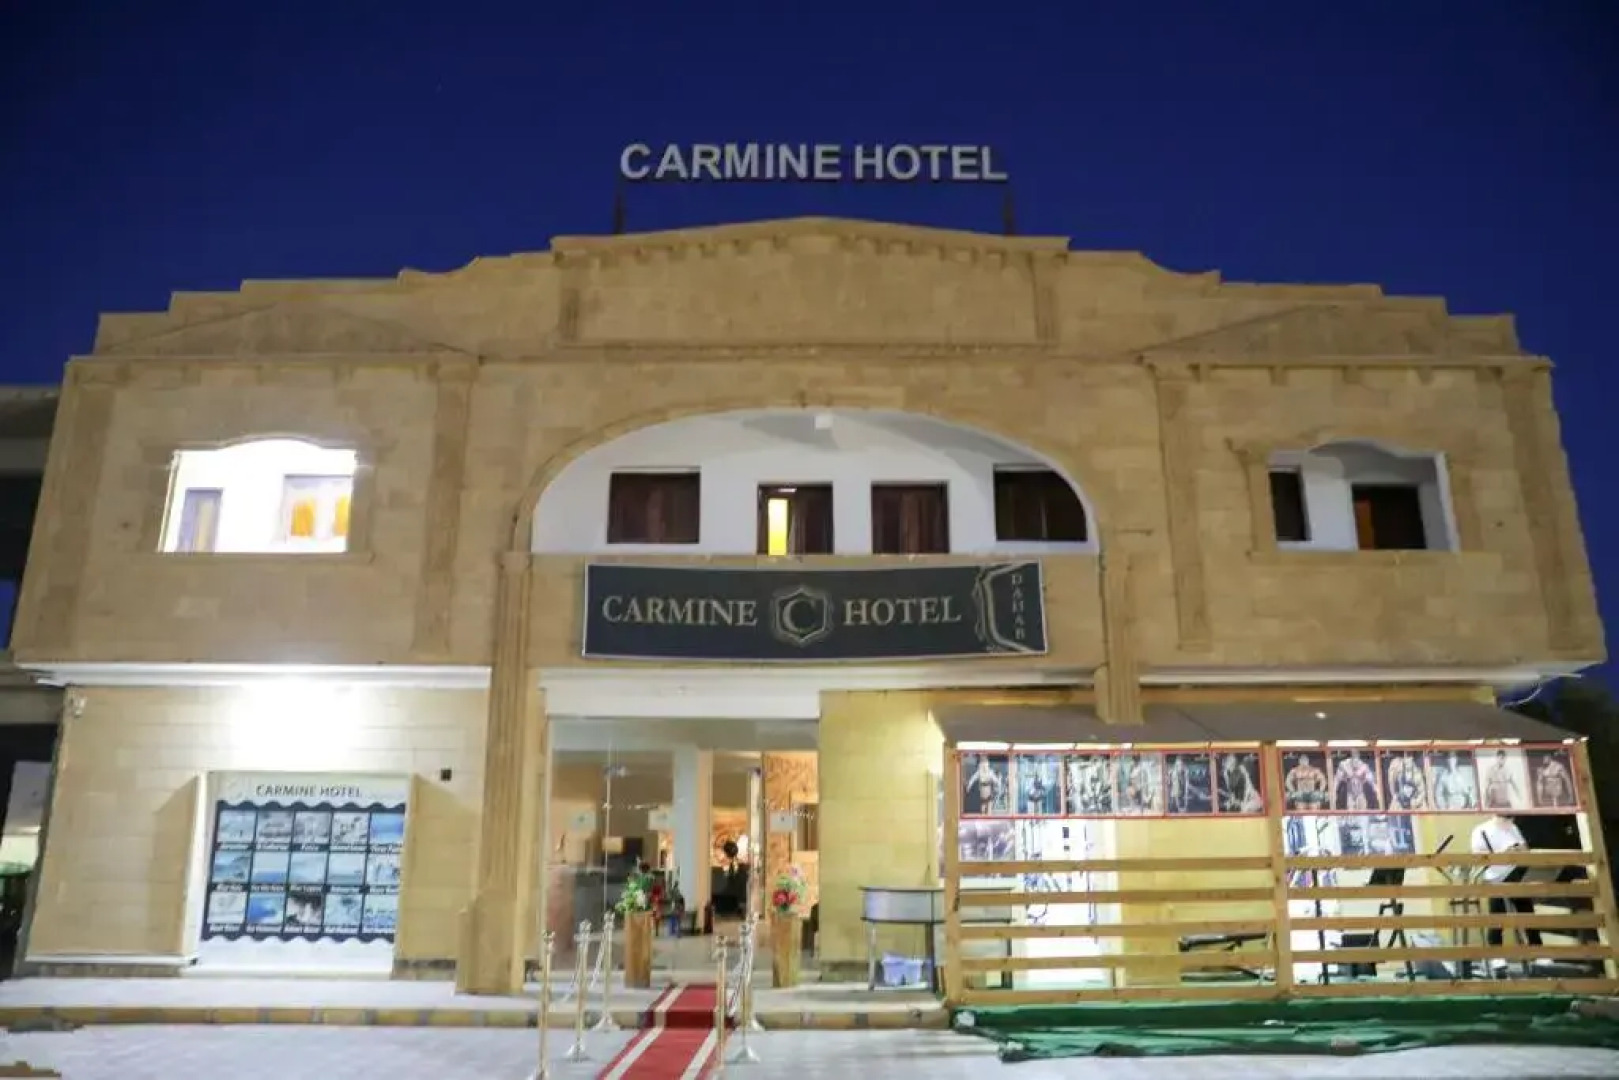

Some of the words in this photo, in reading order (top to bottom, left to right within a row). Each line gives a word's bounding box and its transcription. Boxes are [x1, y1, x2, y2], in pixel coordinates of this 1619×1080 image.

[620, 143, 842, 181] CARMINE
[854, 144, 1008, 181] HOTEL
[602, 595, 758, 627] CARMINE
[843, 596, 962, 625] HOTEL
[255, 784, 317, 797] CARMINE
[320, 784, 362, 797] HOTEL
